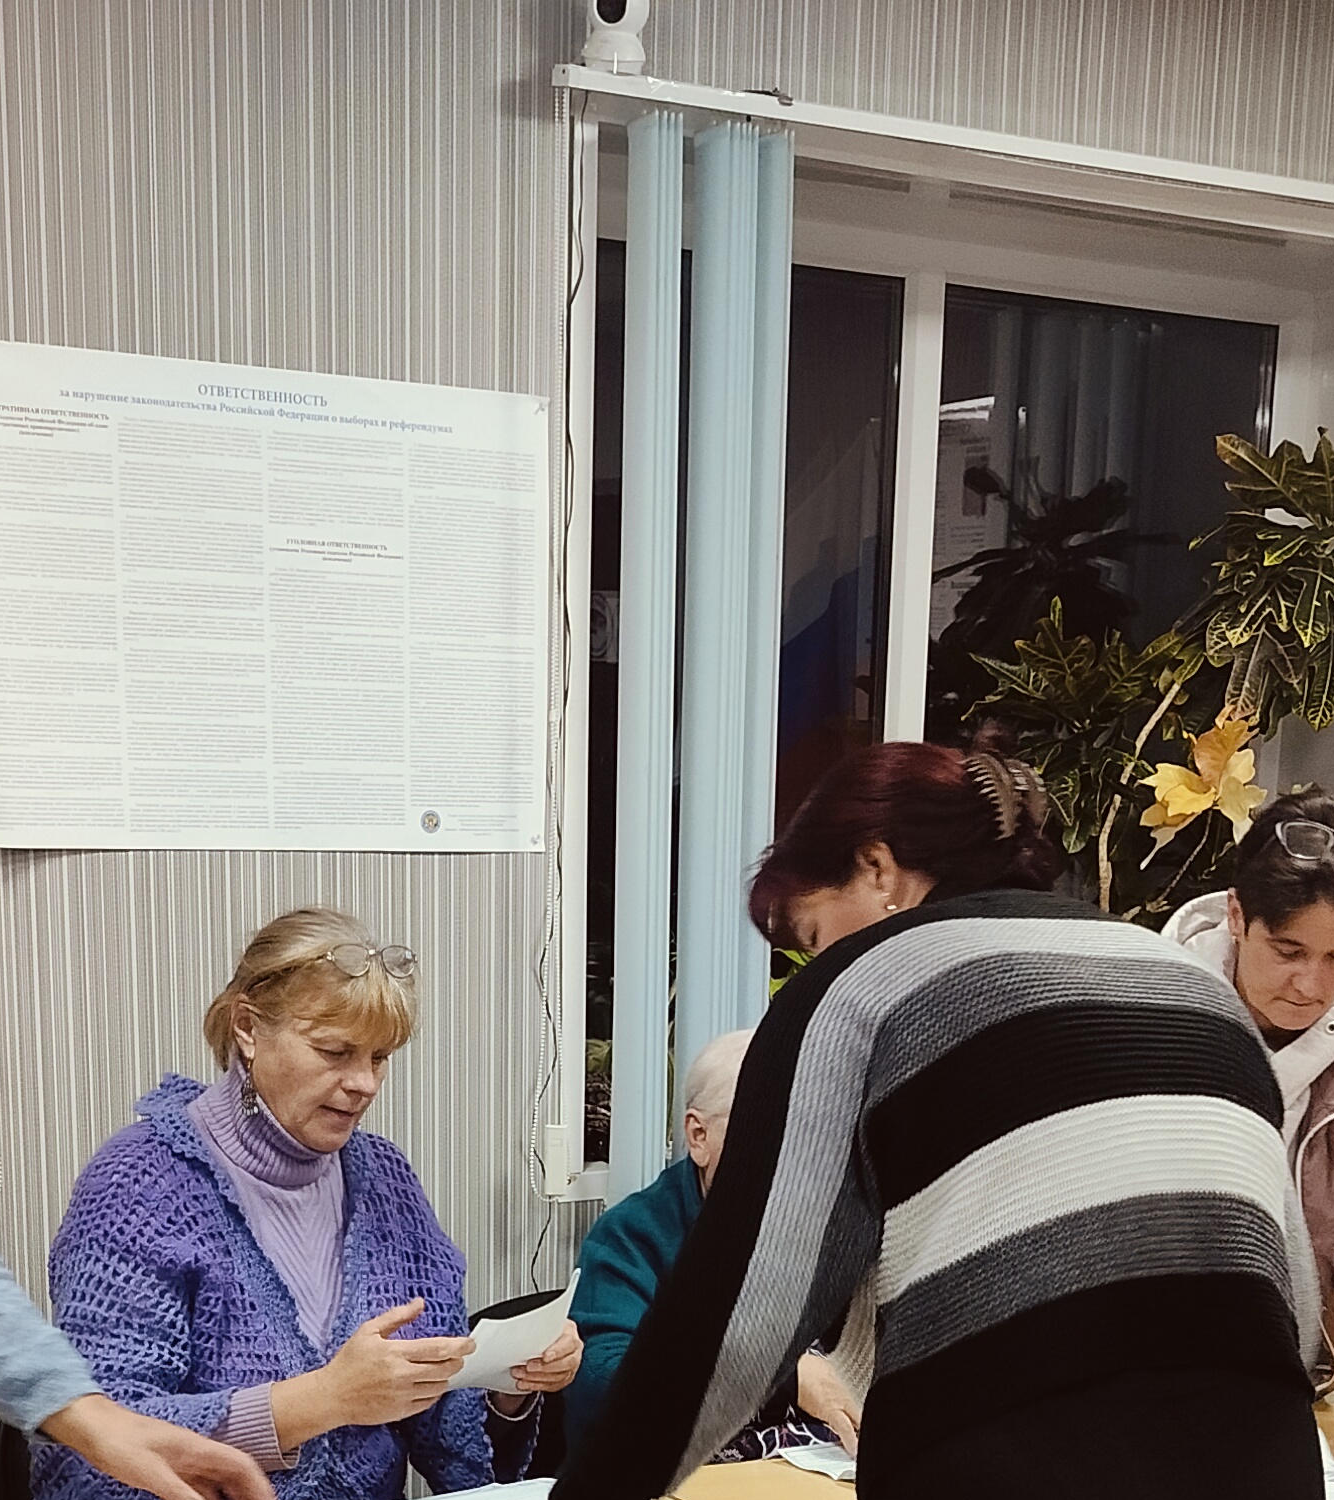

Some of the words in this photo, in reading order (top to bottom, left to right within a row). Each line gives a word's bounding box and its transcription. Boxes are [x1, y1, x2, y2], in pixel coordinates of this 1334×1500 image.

[59, 389, 70, 398] за
[72, 390, 130, 404] нарушение
[131, 394, 217, 412] законодательства
[219, 403, 276, 418] Российской
[277, 408, 330, 424] Федерации
[331, 414, 338, 423] о
[339, 413, 380, 427] выборах
[381, 419, 388, 427] и
[389, 420, 454, 434] референдумах
[198, 384, 328, 408] ОТВЕТСТВЕННОСТЬ
